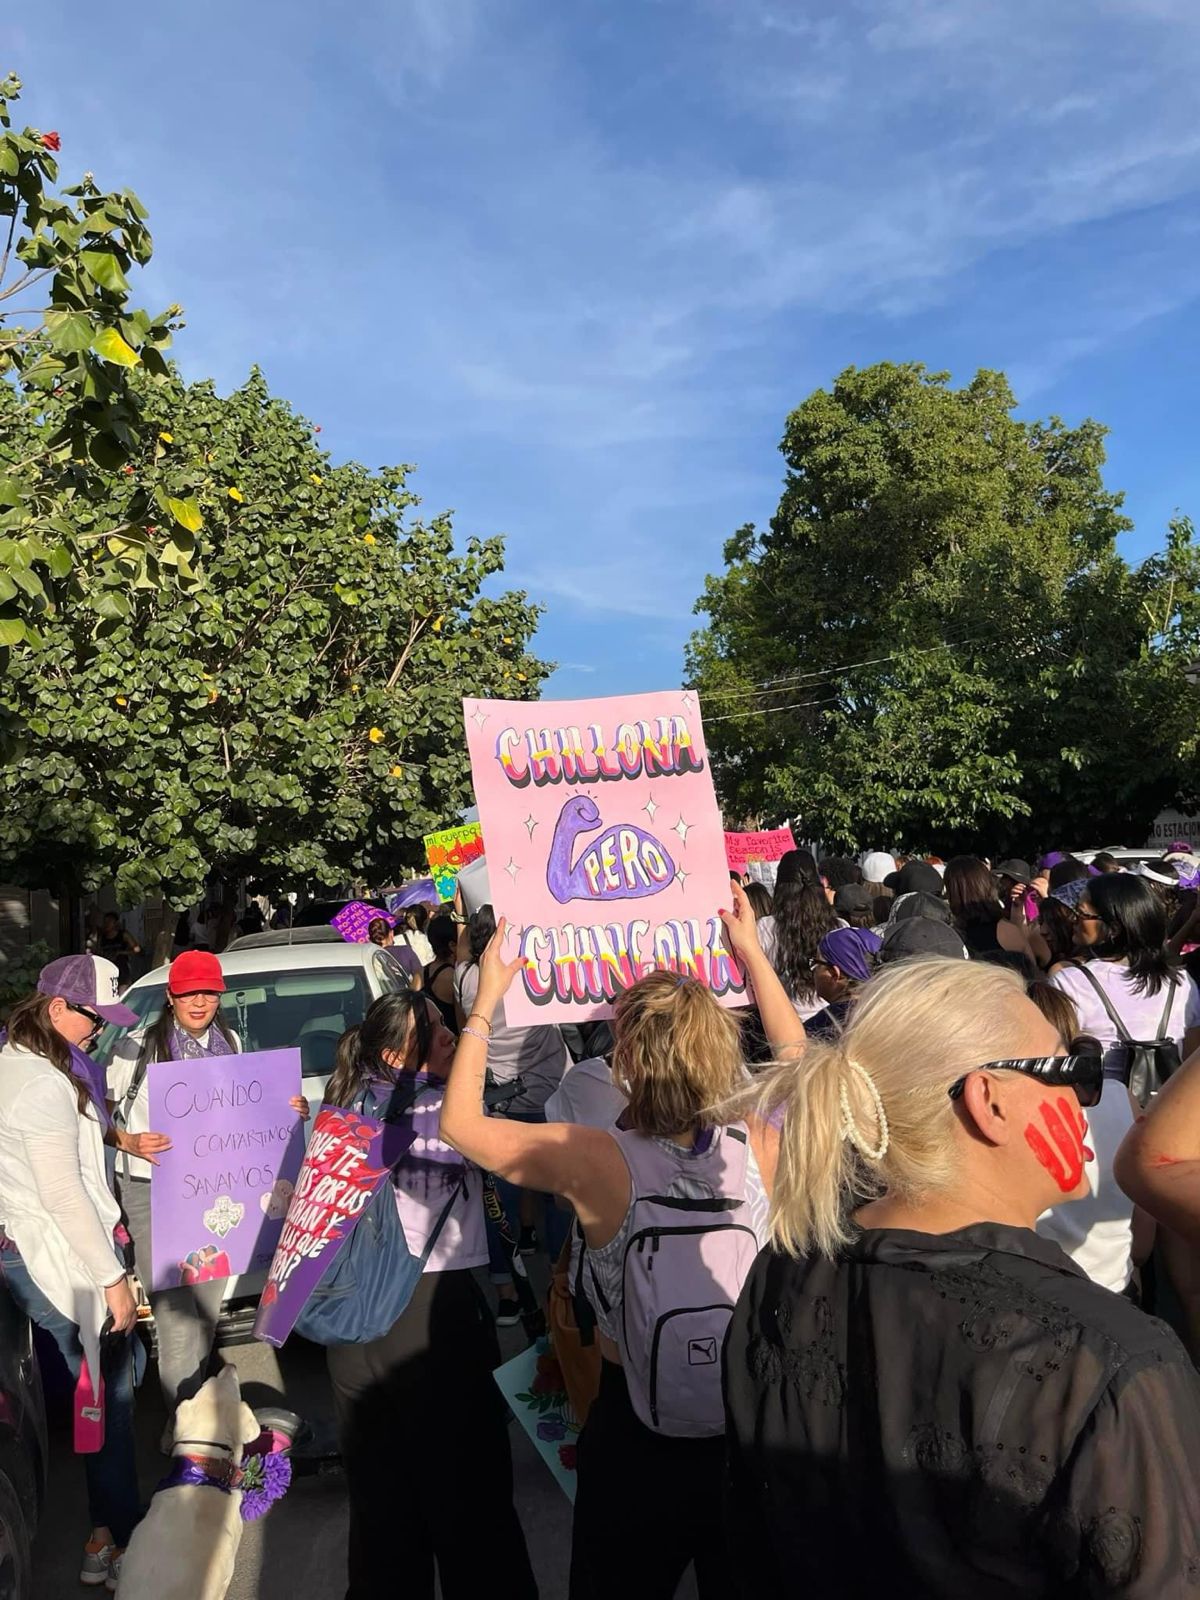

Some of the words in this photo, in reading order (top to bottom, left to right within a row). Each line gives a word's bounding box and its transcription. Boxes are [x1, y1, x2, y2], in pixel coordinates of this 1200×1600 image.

[494, 714, 704, 788] CHILLONA
[583, 828, 667, 895] PERO
[518, 917, 746, 1006] CHINGONA
[164, 1079, 263, 1119] CUANDO
[182, 1163, 274, 1200] SANAMOS
[330, 1145, 368, 1177] TE
[294, 1165, 320, 1198] AS
[308, 1175, 348, 1204] POR
[336, 1185, 373, 1215] LAS
[286, 1197, 329, 1232] CHAN
[321, 1212, 347, 1238] Y
[295, 1232, 330, 1258] QUE
